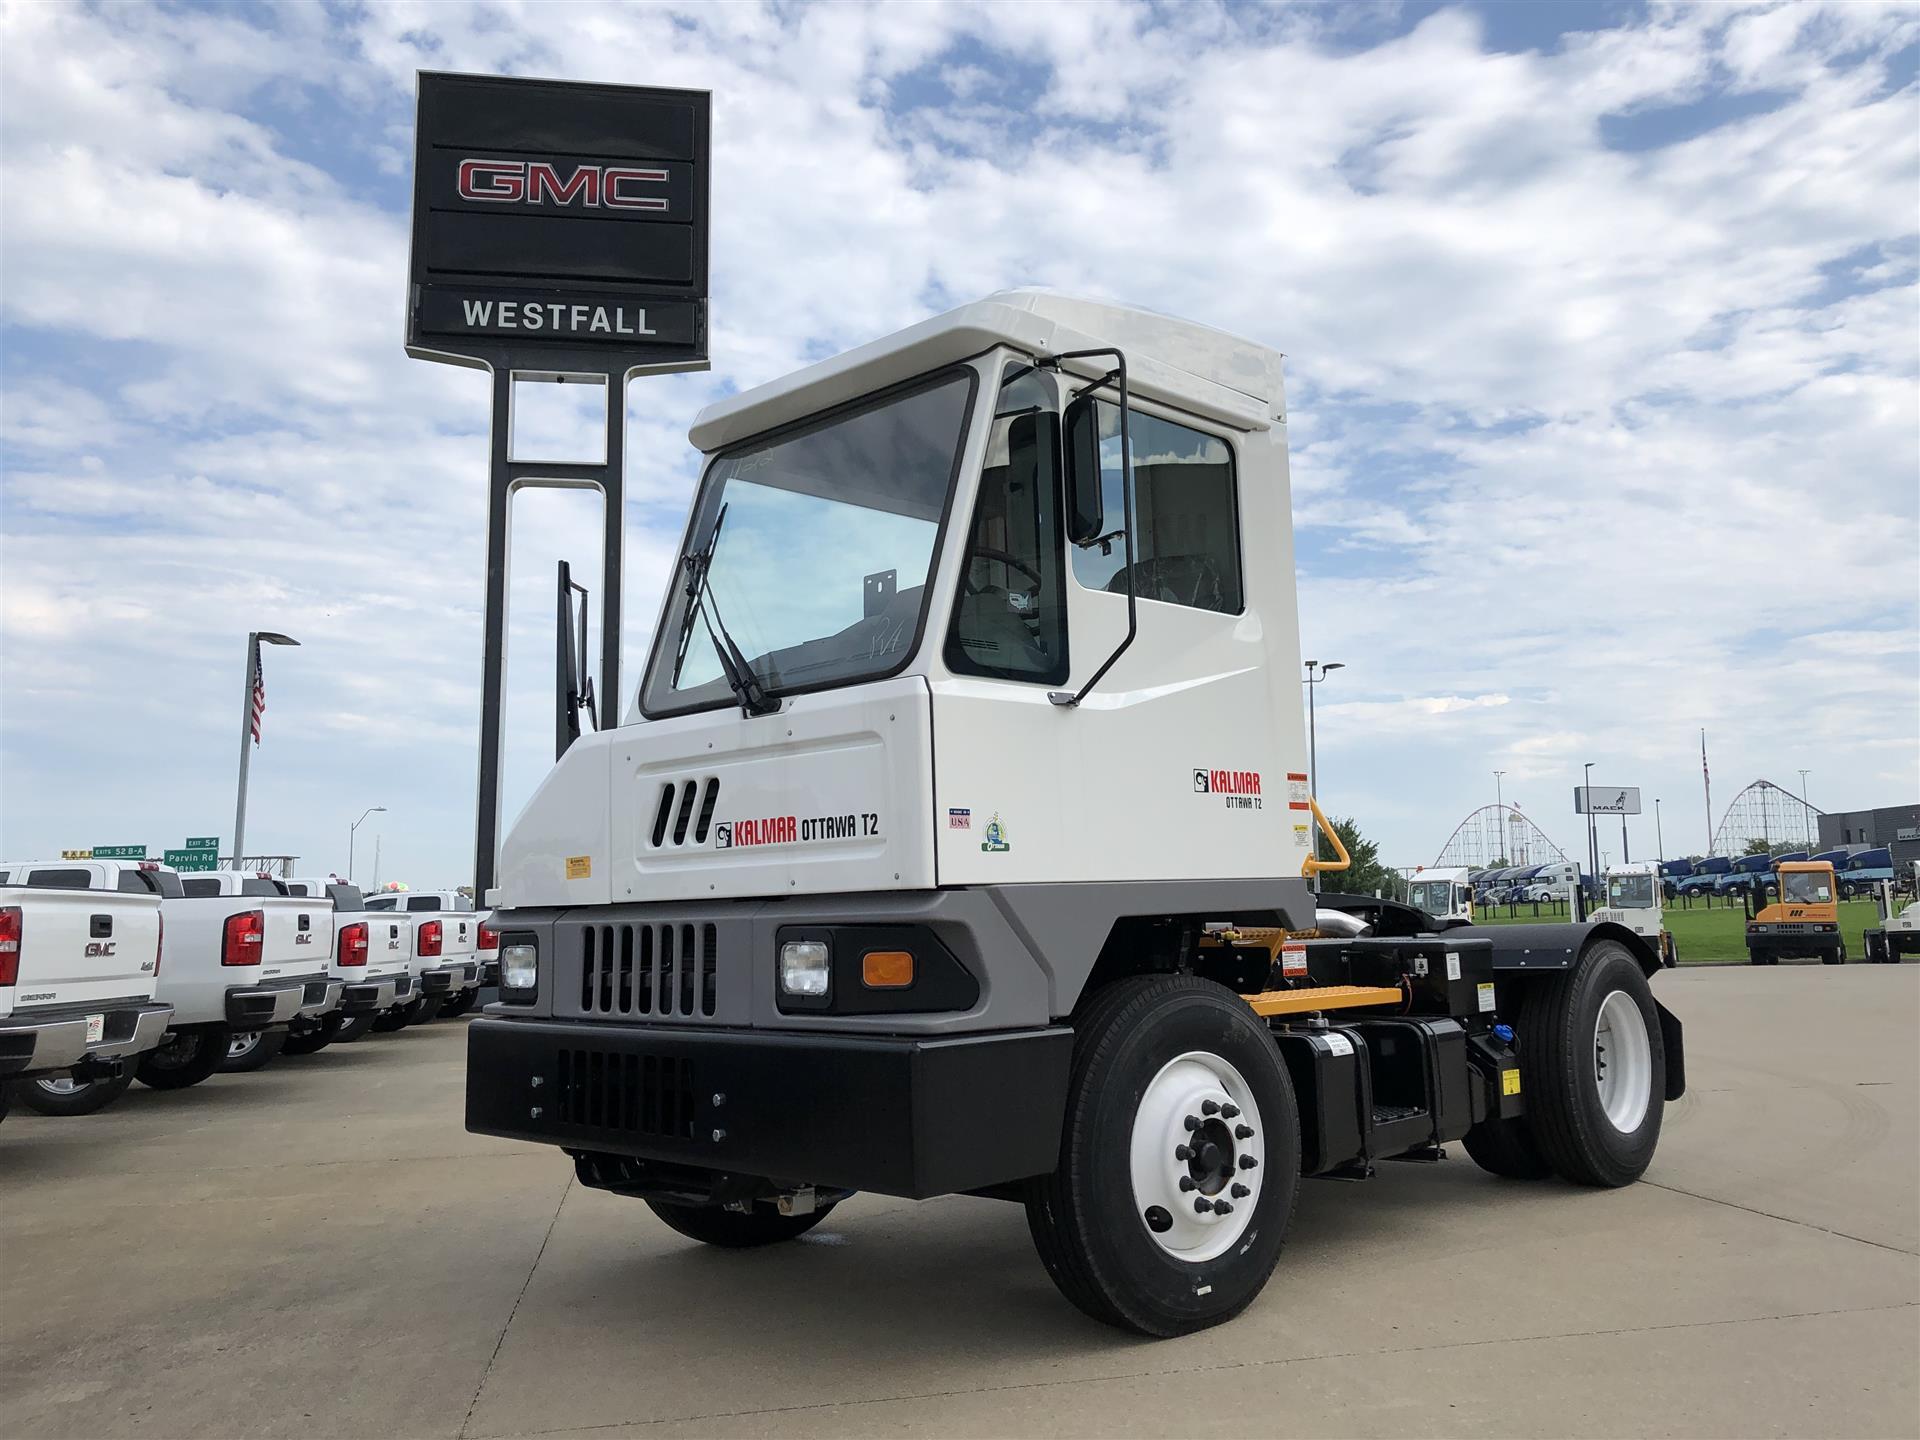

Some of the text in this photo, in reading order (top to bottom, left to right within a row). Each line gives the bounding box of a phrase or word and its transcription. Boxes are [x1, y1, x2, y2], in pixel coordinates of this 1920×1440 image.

[457, 158, 669, 211] GMC
[463, 300, 657, 335] WESTFALL
[1210, 770, 1261, 795] KALMAR
[1226, 796, 1262, 809] OTTAWA T2
[735, 813, 879, 847] KALMAR OTTAWA T2
[951, 817, 969, 827] USA
[169, 854, 198, 862] Parvin
[85, 943, 116, 957] GMC
